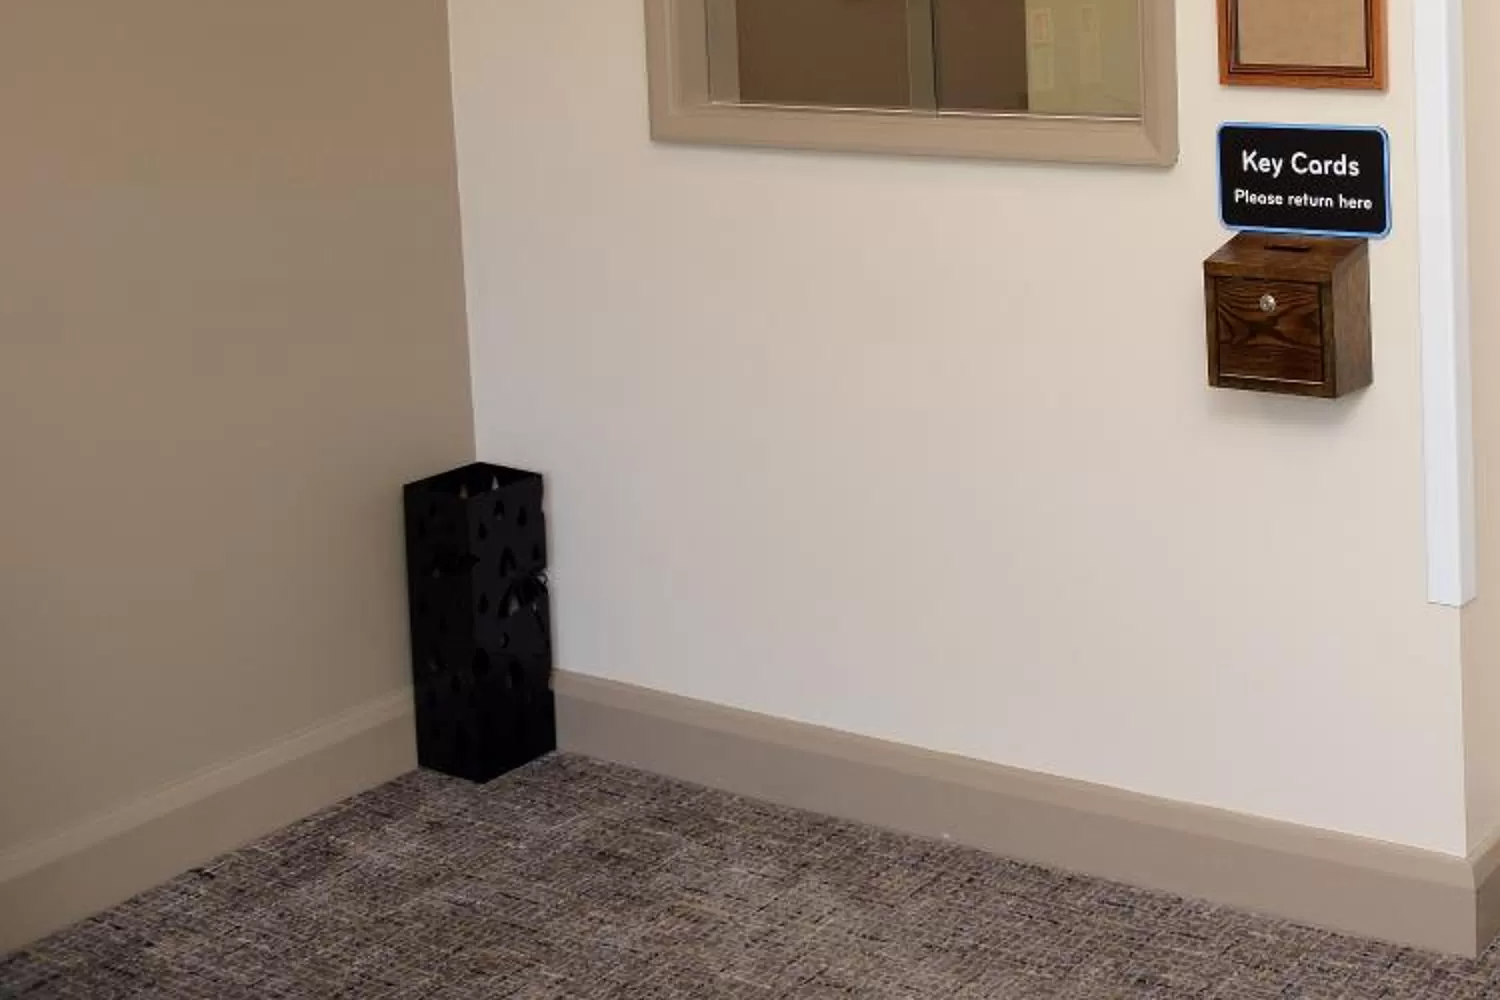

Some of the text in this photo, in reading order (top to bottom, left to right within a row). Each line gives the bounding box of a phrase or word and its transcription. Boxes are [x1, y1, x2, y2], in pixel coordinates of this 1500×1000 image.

[1241, 149, 1360, 178] Key Cards
[1234, 189, 1373, 210] Please return here
